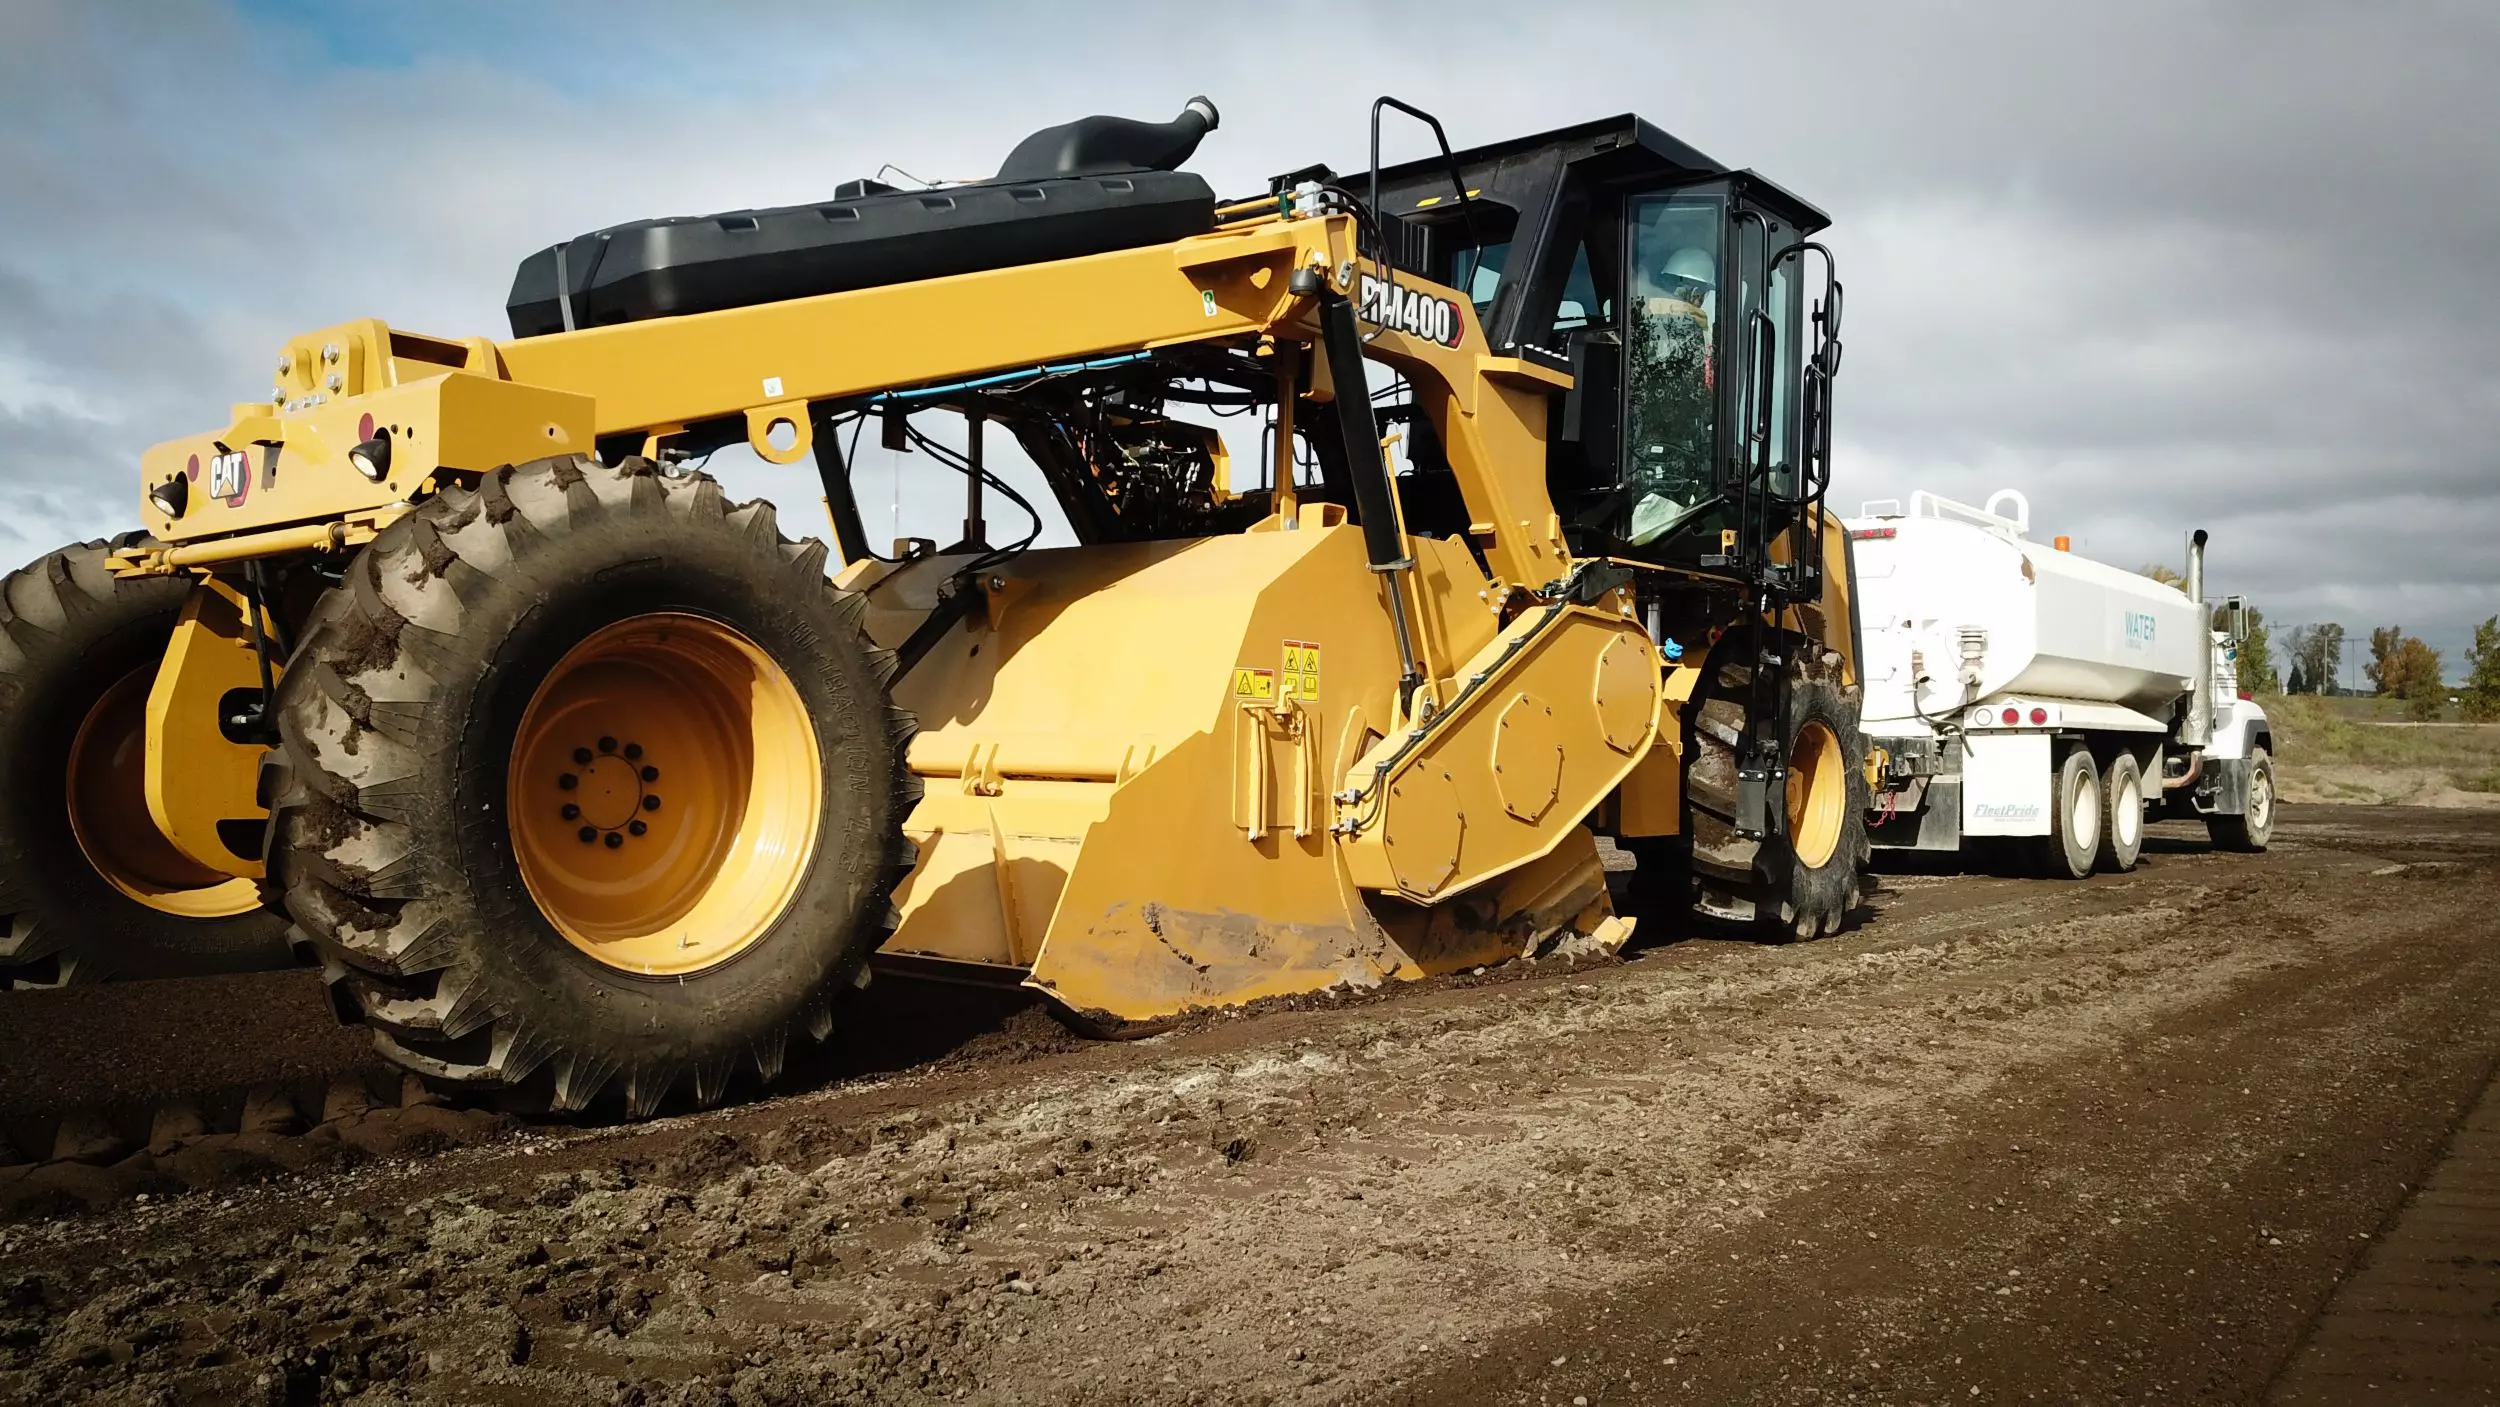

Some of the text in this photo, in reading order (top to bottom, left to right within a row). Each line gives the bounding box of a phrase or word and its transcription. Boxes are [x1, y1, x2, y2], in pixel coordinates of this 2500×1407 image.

[211, 452, 243, 498] CAT
[2125, 610, 2156, 641] WATER
[1974, 803, 2040, 817] FleetPride
